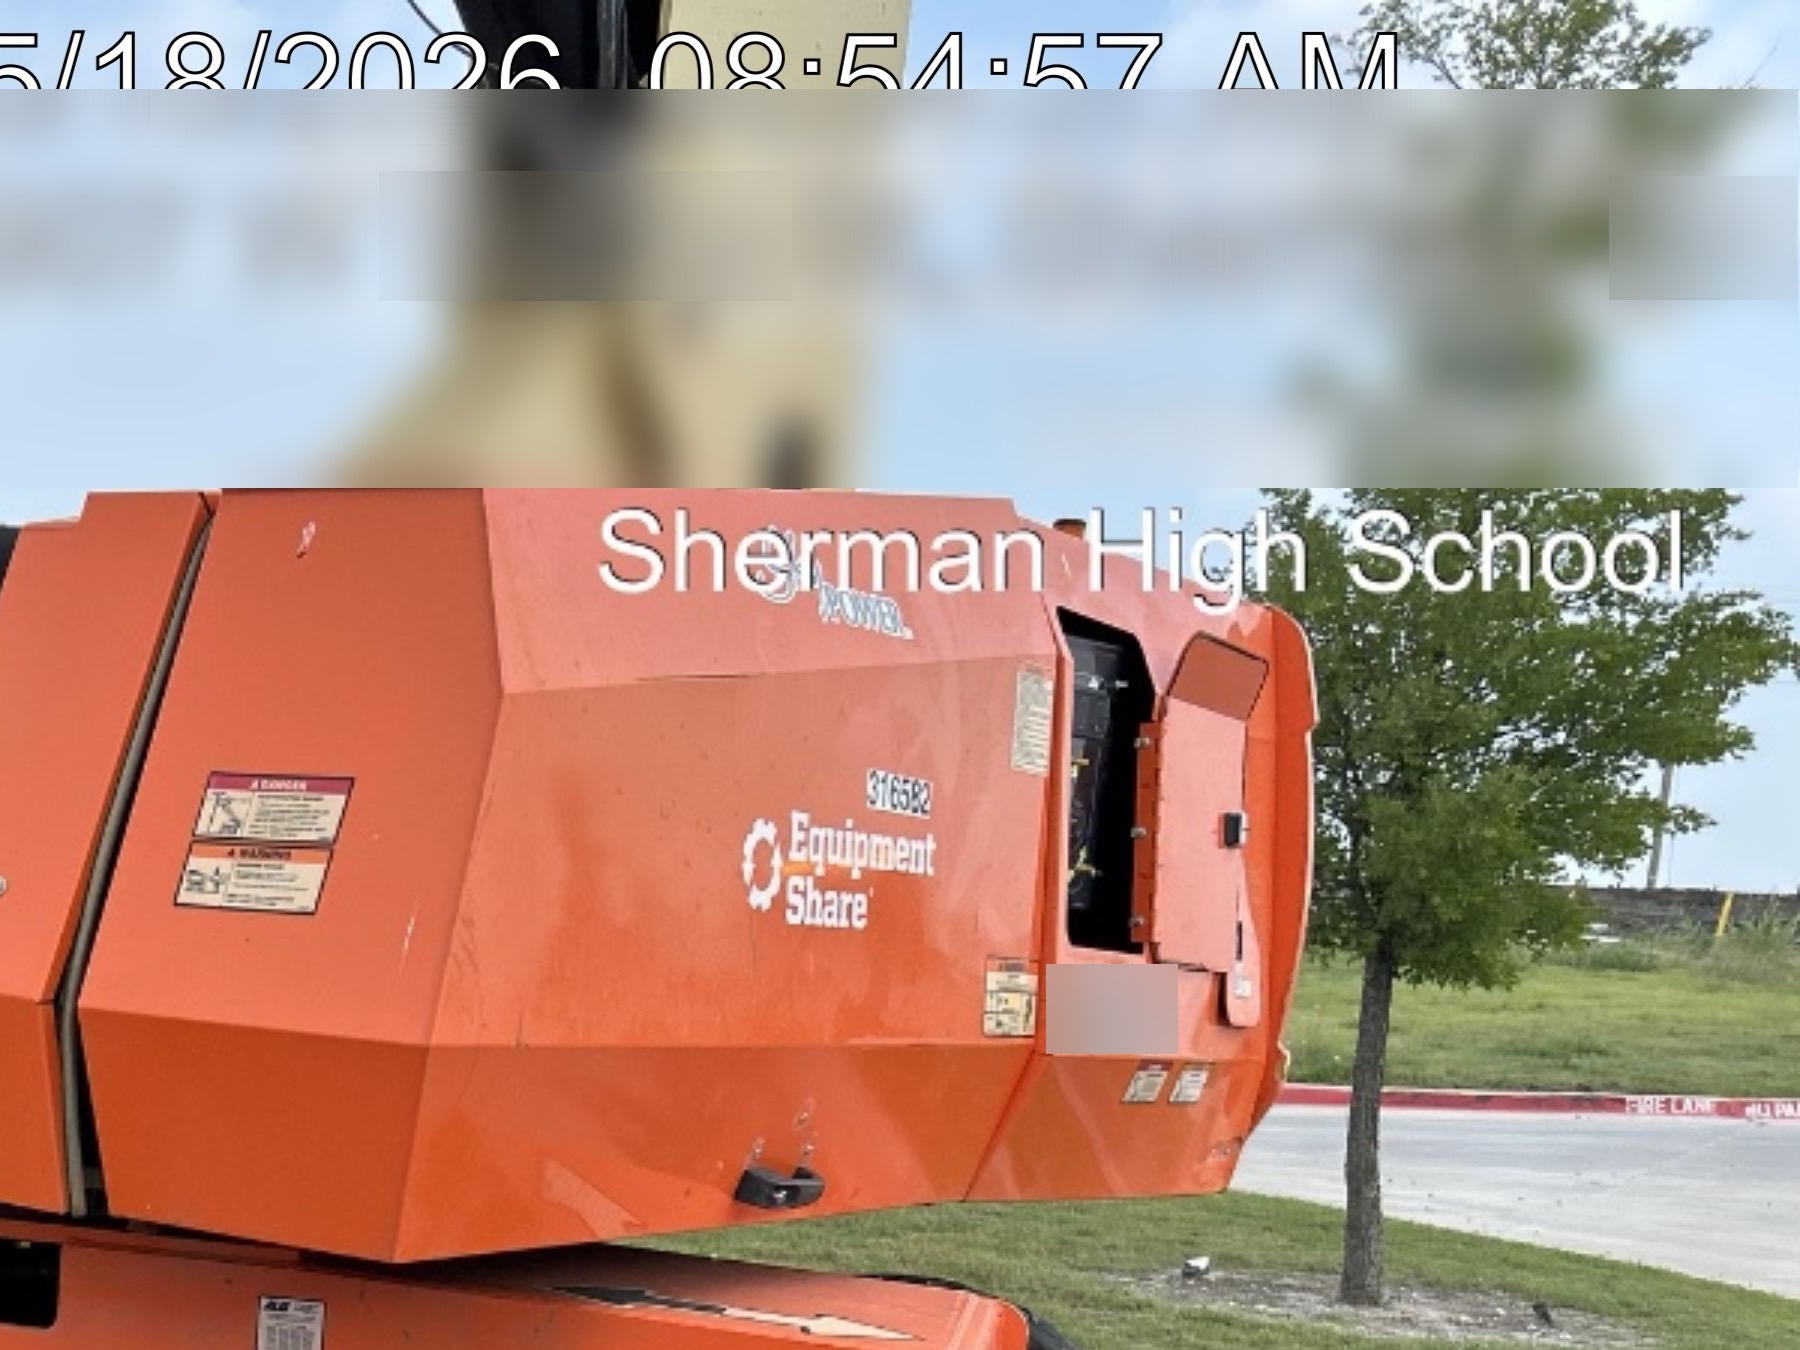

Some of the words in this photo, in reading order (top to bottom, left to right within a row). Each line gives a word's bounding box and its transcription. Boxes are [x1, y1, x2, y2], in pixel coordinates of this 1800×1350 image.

[868, 769, 931, 816] 316582
[788, 809, 937, 880] Equipment
[785, 875, 868, 929] Share
